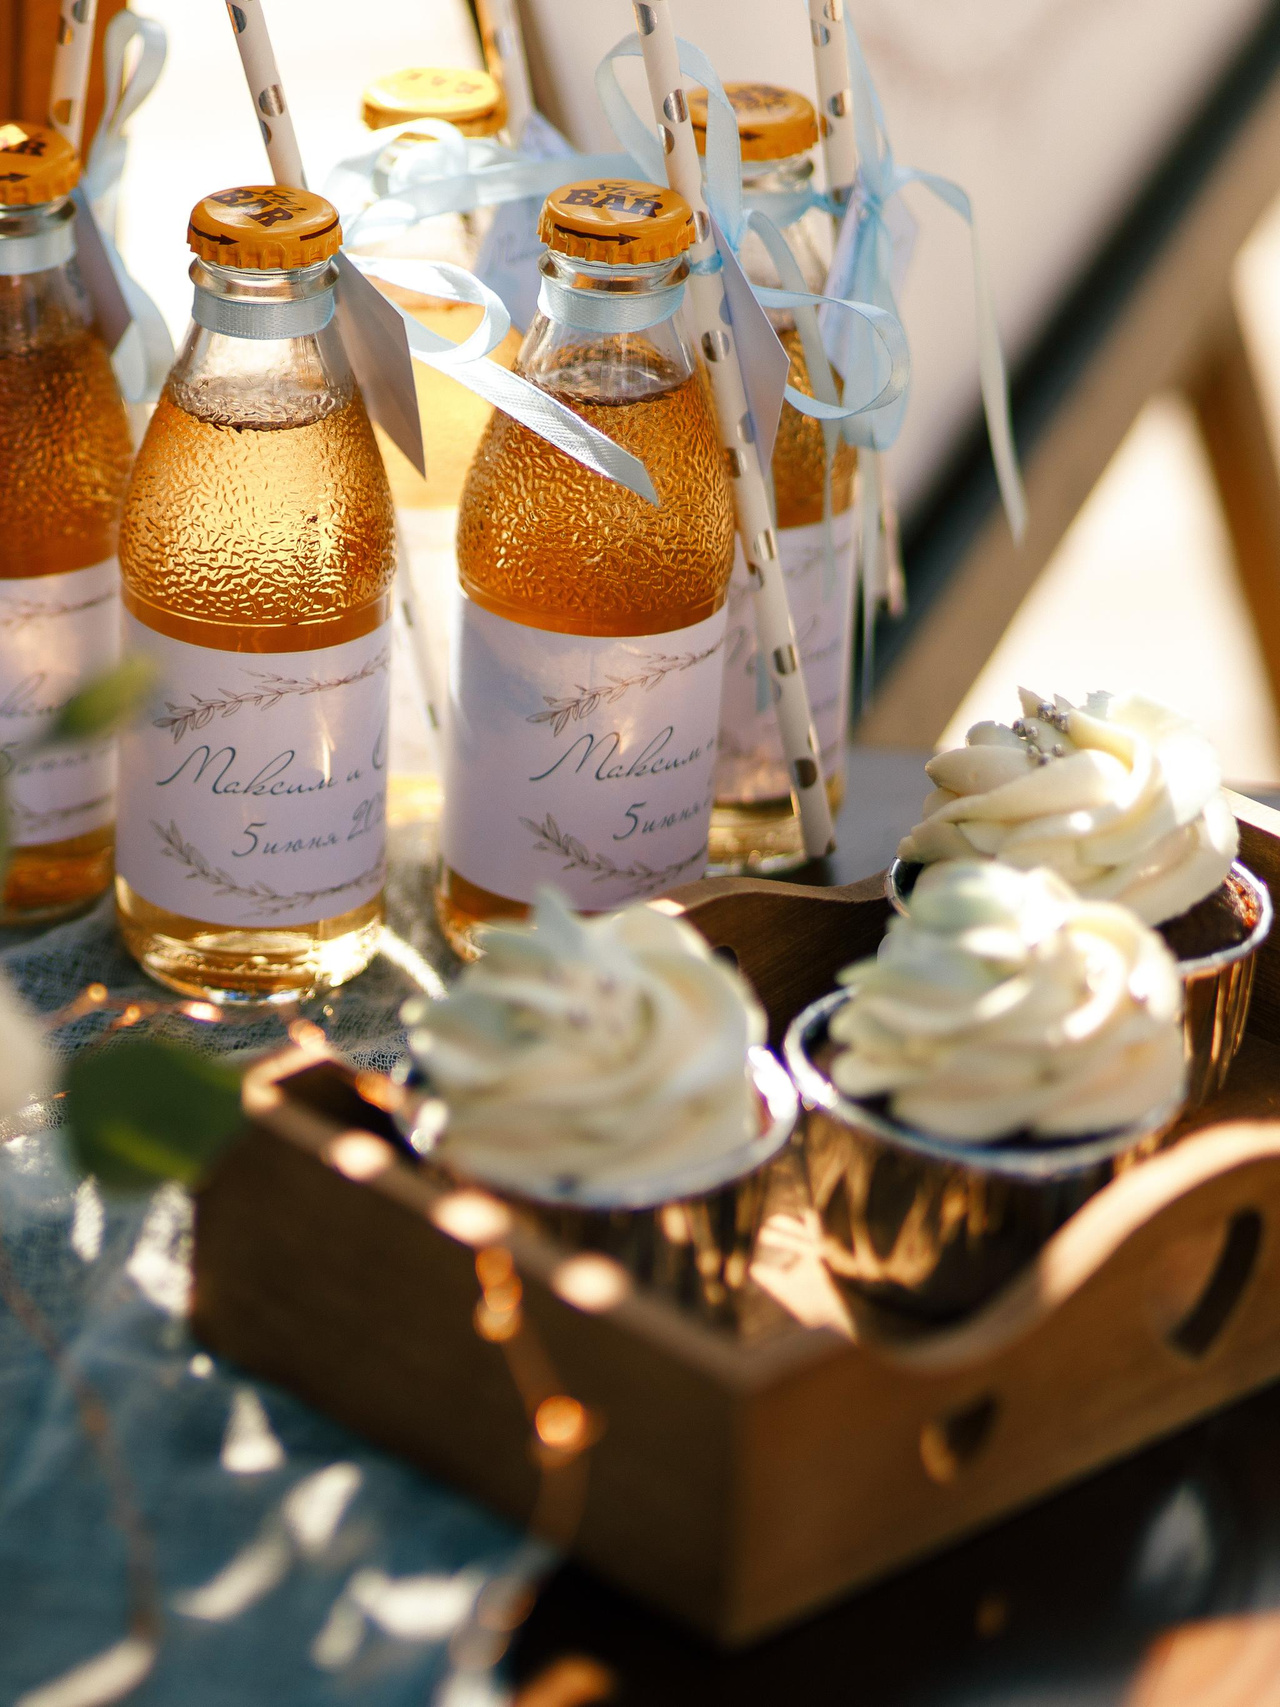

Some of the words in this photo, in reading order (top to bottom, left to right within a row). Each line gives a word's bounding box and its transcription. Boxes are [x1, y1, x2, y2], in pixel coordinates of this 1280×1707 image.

[559, 189, 663, 218] BAR
[156, 745, 338, 795] Максим
[529, 726, 701, 782] Максим
